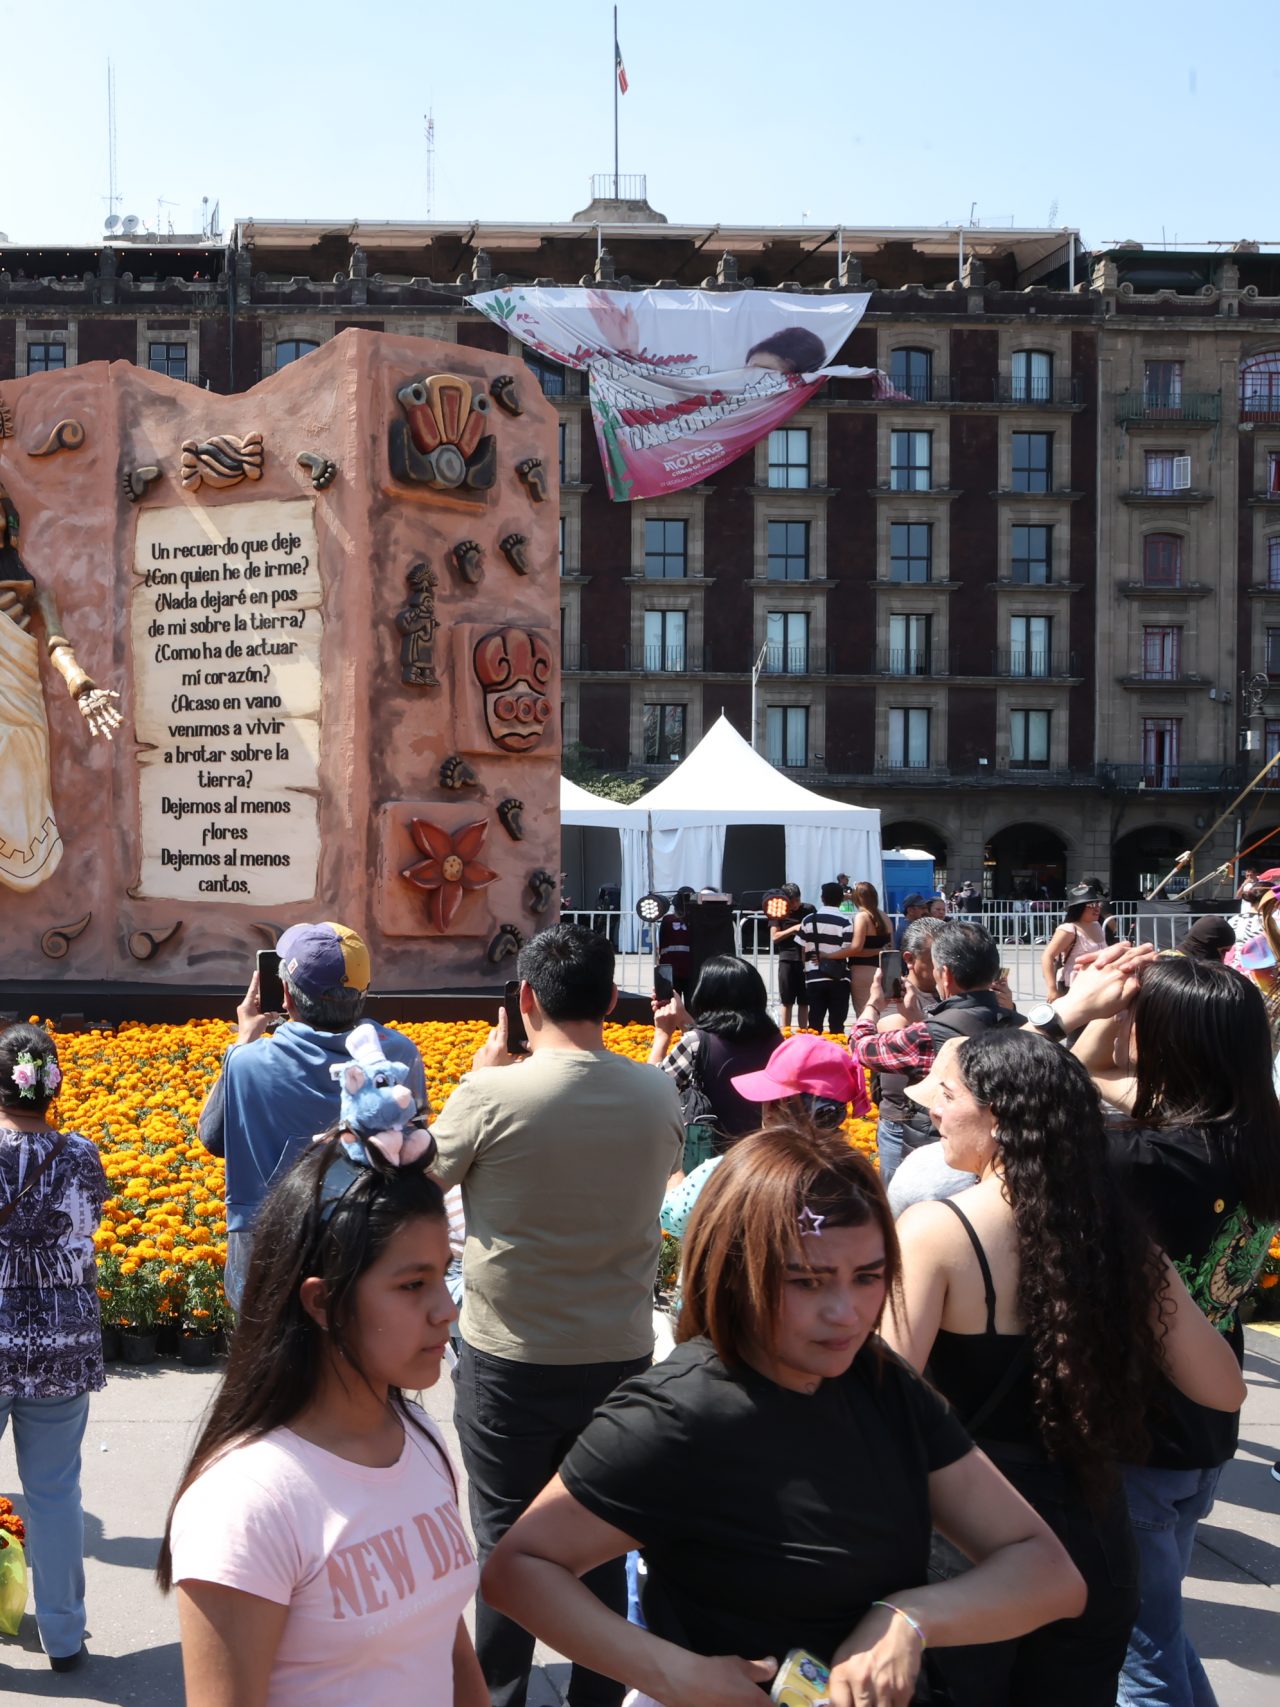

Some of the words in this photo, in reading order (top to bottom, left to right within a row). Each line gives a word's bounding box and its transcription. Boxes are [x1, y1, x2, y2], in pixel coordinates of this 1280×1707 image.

[662, 442, 725, 472] morena
[151, 543, 170, 560] Un
[173, 537, 239, 560] recuerdo
[241, 540, 268, 560] que
[271, 532, 301, 556] deje
[180, 566, 220, 589] quien
[222, 561, 241, 581] he
[244, 561, 261, 580] de
[264, 555, 310, 578] irme?
[155, 590, 198, 613] ¿Nada
[200, 588, 247, 614] dejaré
[250, 593, 268, 606] en
[271, 589, 298, 609] pos
[148, 619, 165, 638] de
[167, 618, 187, 636] mi
[189, 615, 231, 635] sobre
[234, 613, 247, 631] la
[250, 609, 306, 631] tierra?
[154, 643, 201, 664] ¿Como
[203, 642, 222, 659] ha
[225, 640, 243, 658] de
[246, 637, 298, 656] actuar
[204, 664, 270, 685] corazón?
[171, 694, 220, 714] ¿Acaso
[223, 697, 241, 710] en
[245, 695, 282, 710] vano
[168, 723, 230, 738] venimos
[233, 723, 242, 736] a
[245, 717, 286, 735] vivir
[164, 751, 173, 764] a
[176, 745, 227, 764] brotar
[230, 743, 273, 761] sobre
[275, 742, 289, 761] la
[197, 769, 253, 789] tierra?
[161, 796, 221, 820] Dejemos
[224, 796, 238, 814] al
[240, 800, 291, 815] menos
[202, 822, 248, 846] flores
[161, 848, 221, 871] Dejemos
[224, 848, 237, 866] al
[240, 852, 291, 867] menos
[198, 874, 251, 894] cantos.
[325, 1526, 416, 1620] NEW
